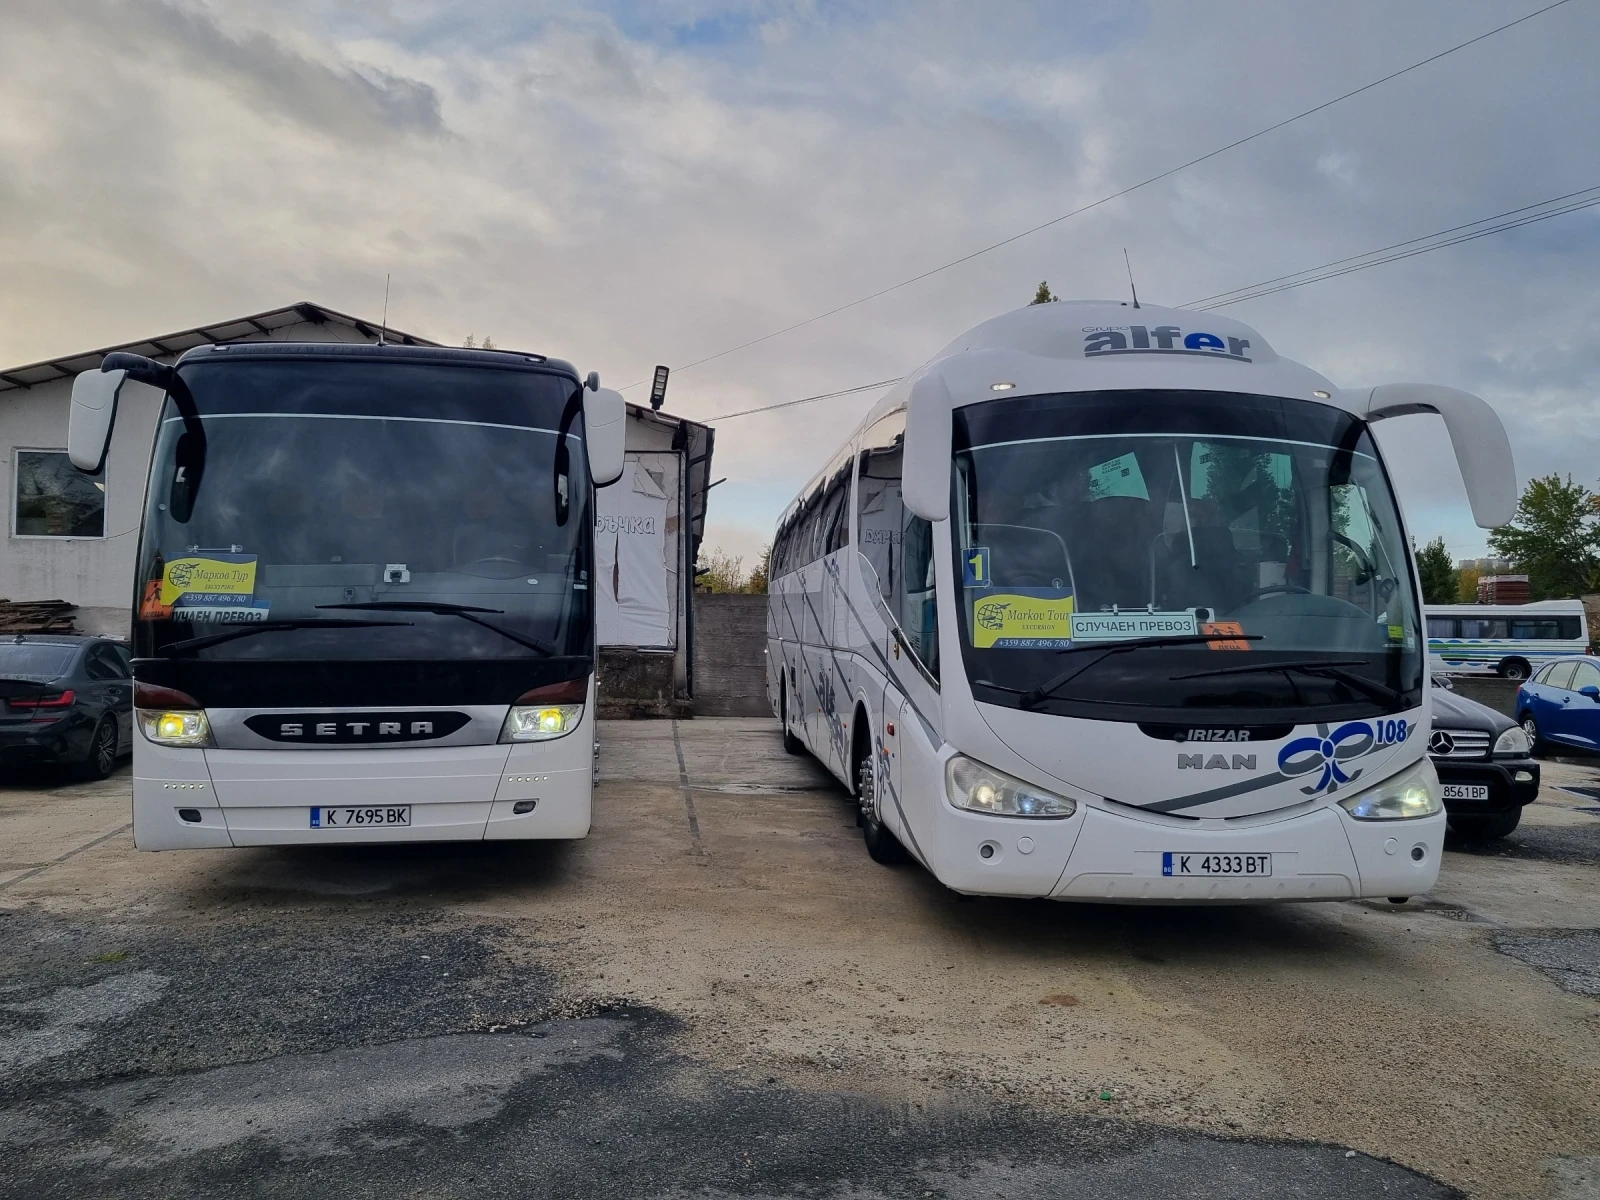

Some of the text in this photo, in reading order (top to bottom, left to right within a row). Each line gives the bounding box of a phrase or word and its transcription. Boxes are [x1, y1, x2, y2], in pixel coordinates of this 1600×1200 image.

[1081, 325, 1129, 333] Grupo
[1083, 325, 1251, 357] alfer
[968, 554, 983, 580] 1
[194, 569, 249, 583] Марков Тур
[184, 594, 203, 602] +359
[203, 594, 216, 602] 887
[219, 594, 231, 602] 496
[1007, 609, 1045, 621] Markov
[1075, 620, 1192, 632] СЛУЧАЕН ПРЕВОЗ
[999, 639, 1070, 648] +359 887 496 780
[280, 721, 433, 736] SETRA
[1187, 729, 1250, 742] IRIZAR
[1375, 719, 1408, 745] 108
[1177, 753, 1257, 770] MAN
[327, 810, 337, 825] K
[1180, 856, 1191, 873] K
